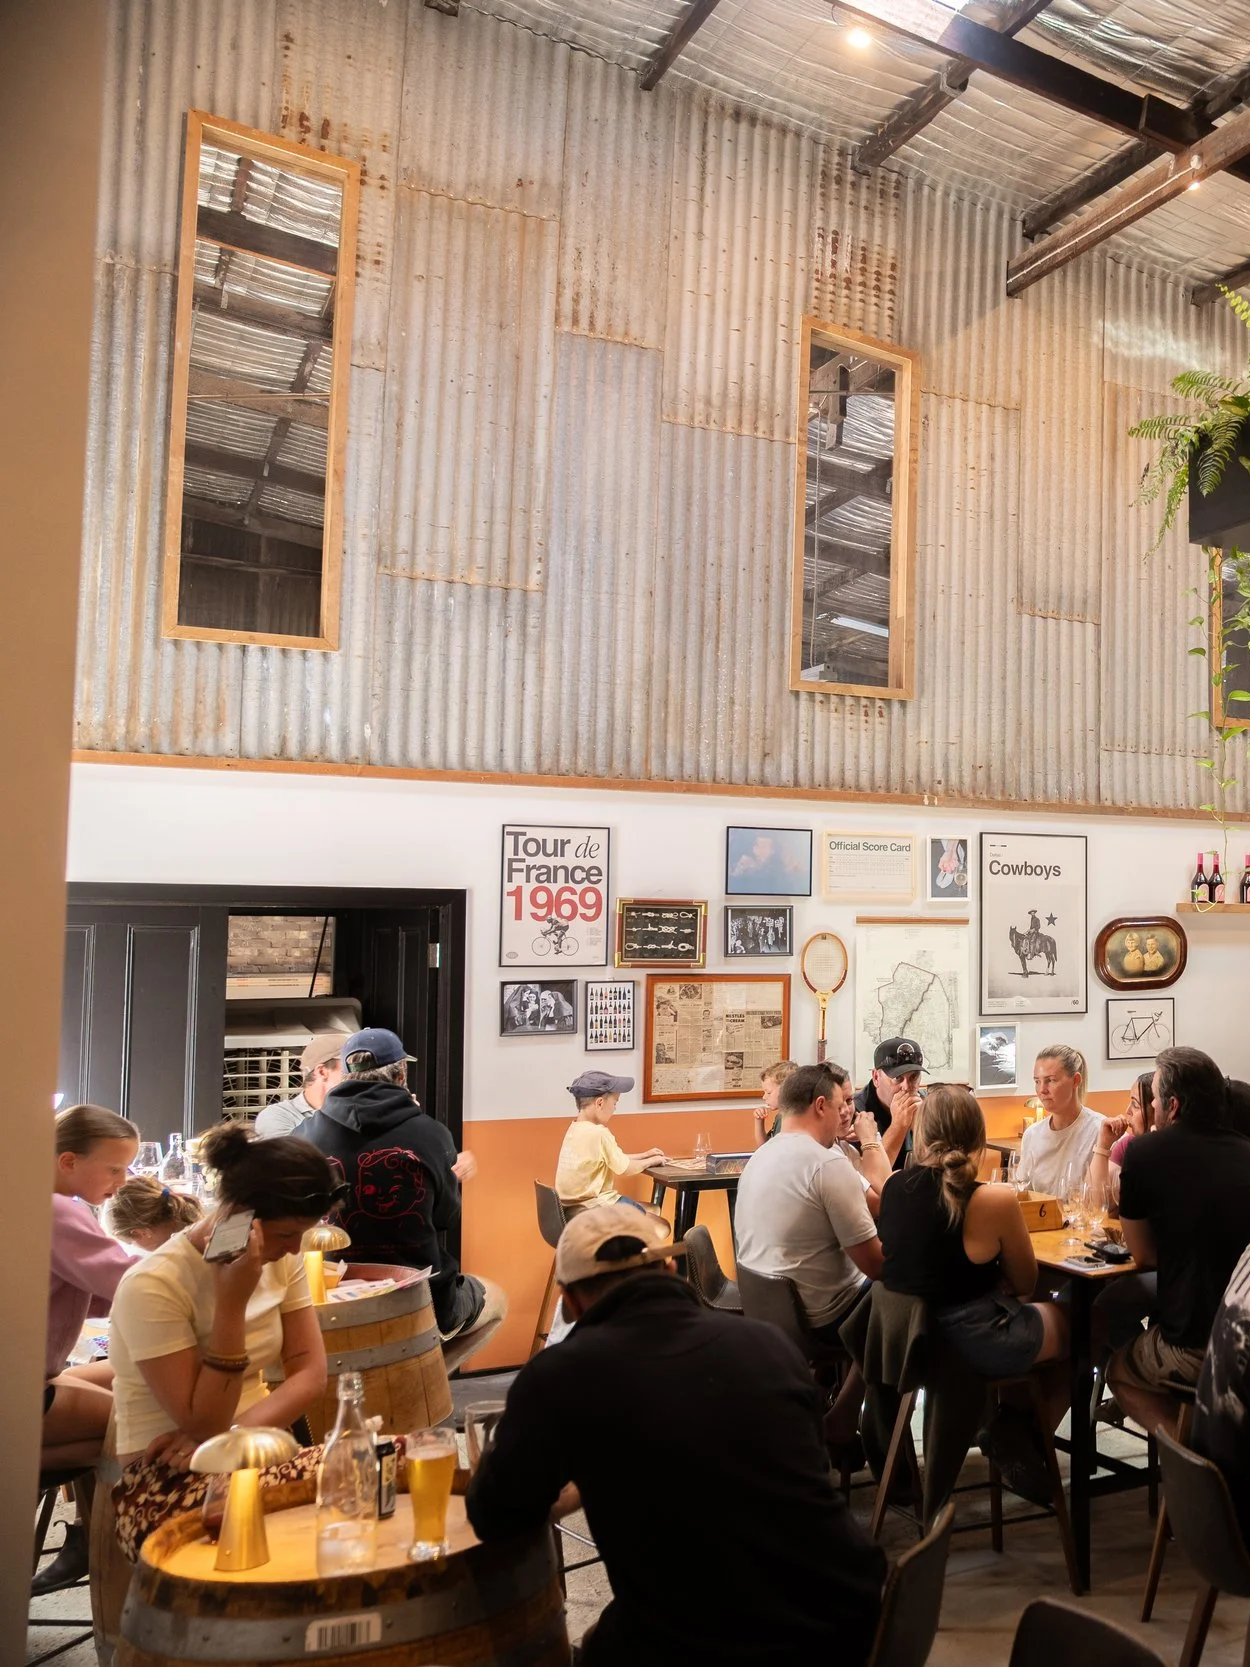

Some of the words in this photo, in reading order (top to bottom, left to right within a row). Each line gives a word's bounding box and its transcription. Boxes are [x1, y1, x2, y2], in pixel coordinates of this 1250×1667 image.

[506, 831, 571, 857] Tour
[575, 835, 600, 858] de
[829, 841, 860, 850] Official
[862, 842, 888, 851] Score
[890, 843, 911, 851] Card
[507, 858, 603, 884] France
[989, 860, 1061, 880] Cowboys
[506, 885, 603, 922] 1969
[1039, 1203, 1047, 1217] 6
